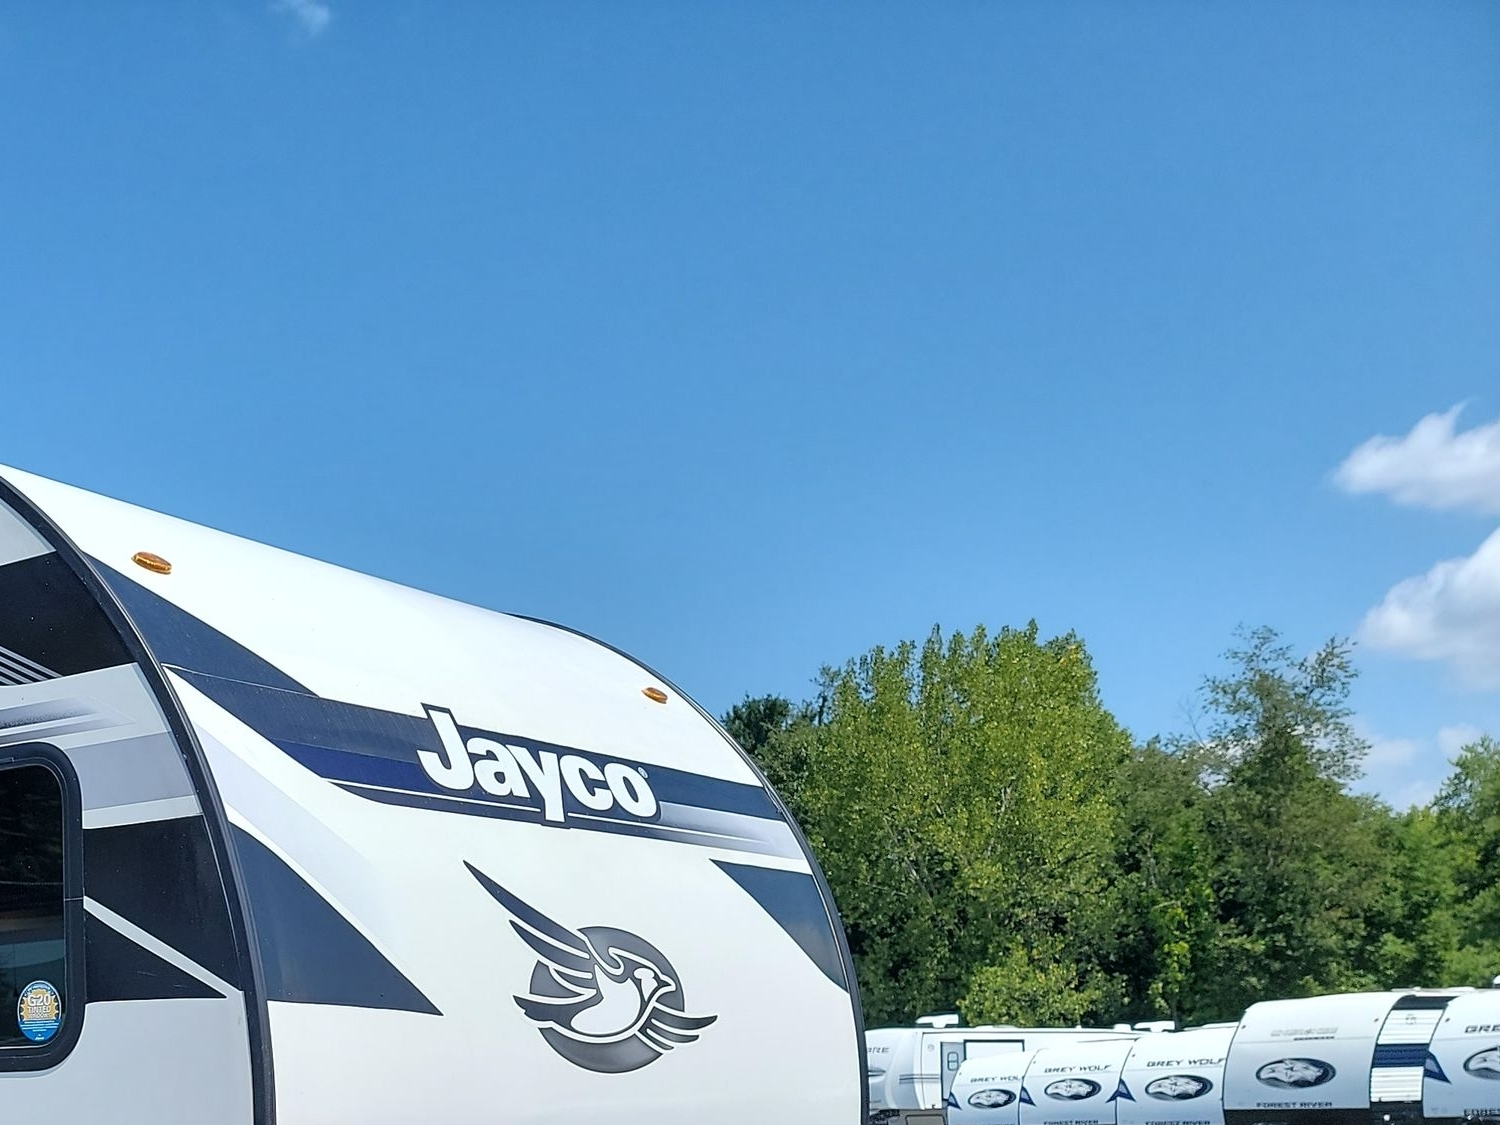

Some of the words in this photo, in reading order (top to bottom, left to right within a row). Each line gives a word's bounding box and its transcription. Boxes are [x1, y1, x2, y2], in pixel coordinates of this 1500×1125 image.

[417, 708, 659, 823] Jayco
[27, 994, 51, 1007] G20
[1464, 1023, 1500, 1034] GRE
[1146, 1059, 1186, 1068] GREY
[1187, 1057, 1227, 1066] WOLF
[1043, 1065, 1076, 1074] GREY
[1078, 1063, 1112, 1072] WOLF
[999, 1074, 1022, 1082] WOL
[1255, 1101, 1297, 1109] FOREST
